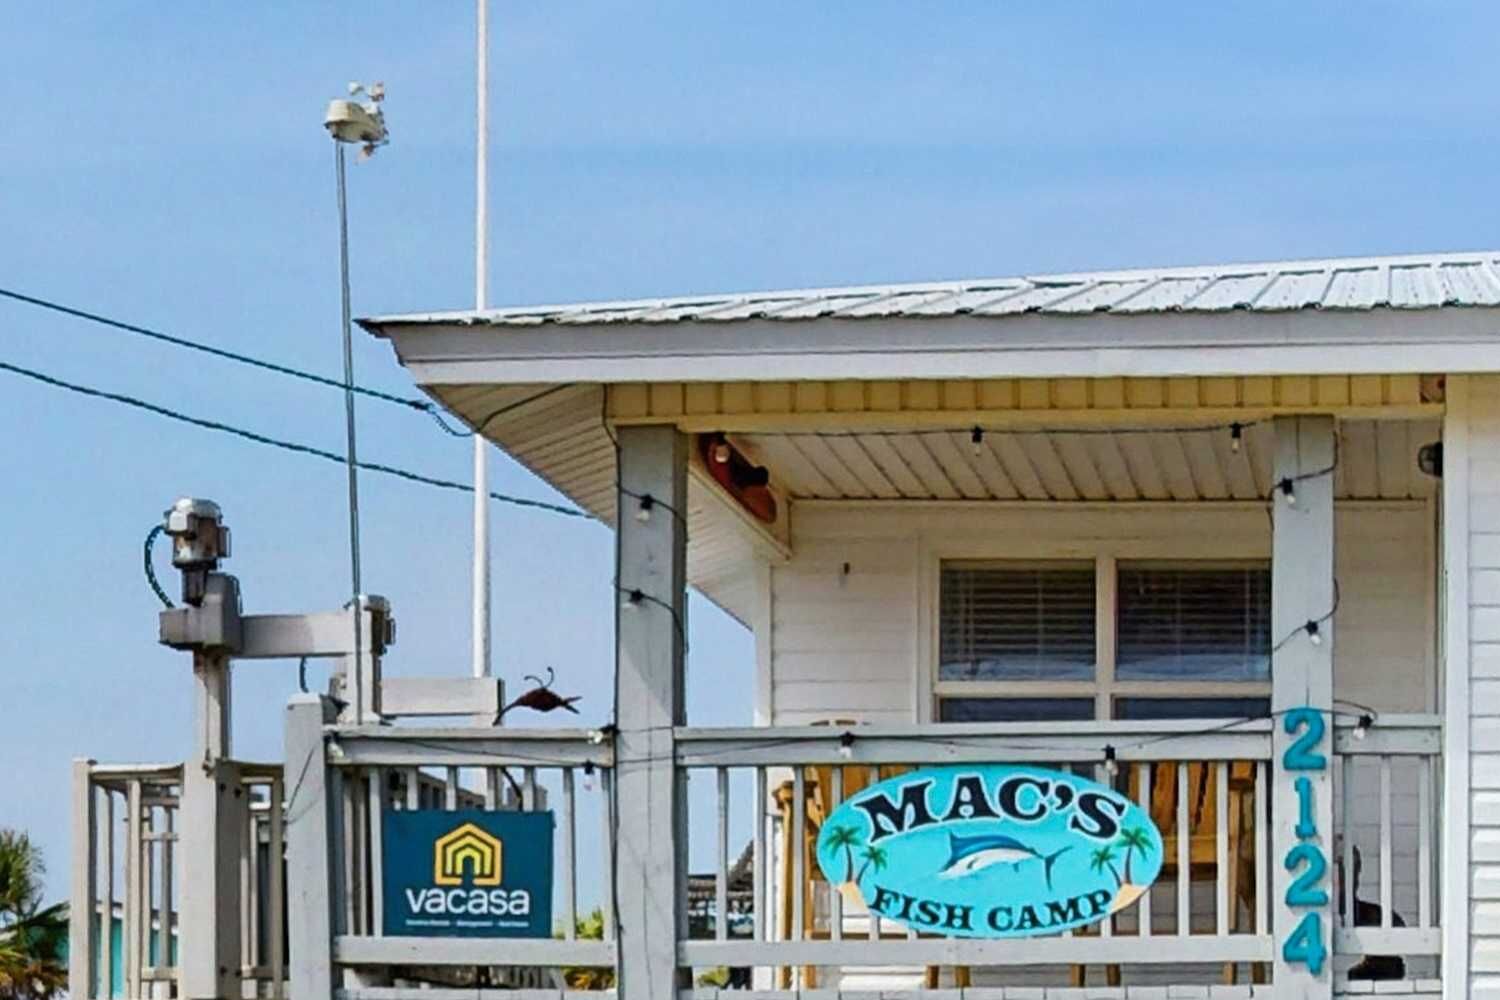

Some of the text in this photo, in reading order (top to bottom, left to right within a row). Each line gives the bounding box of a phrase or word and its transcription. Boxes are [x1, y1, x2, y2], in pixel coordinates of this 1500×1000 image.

[856, 776, 1126, 843] MAC'S
[1283, 707, 1329, 976] 2124
[405, 888, 530, 915] vacasa
[869, 886, 1112, 932] FISH CAMP
